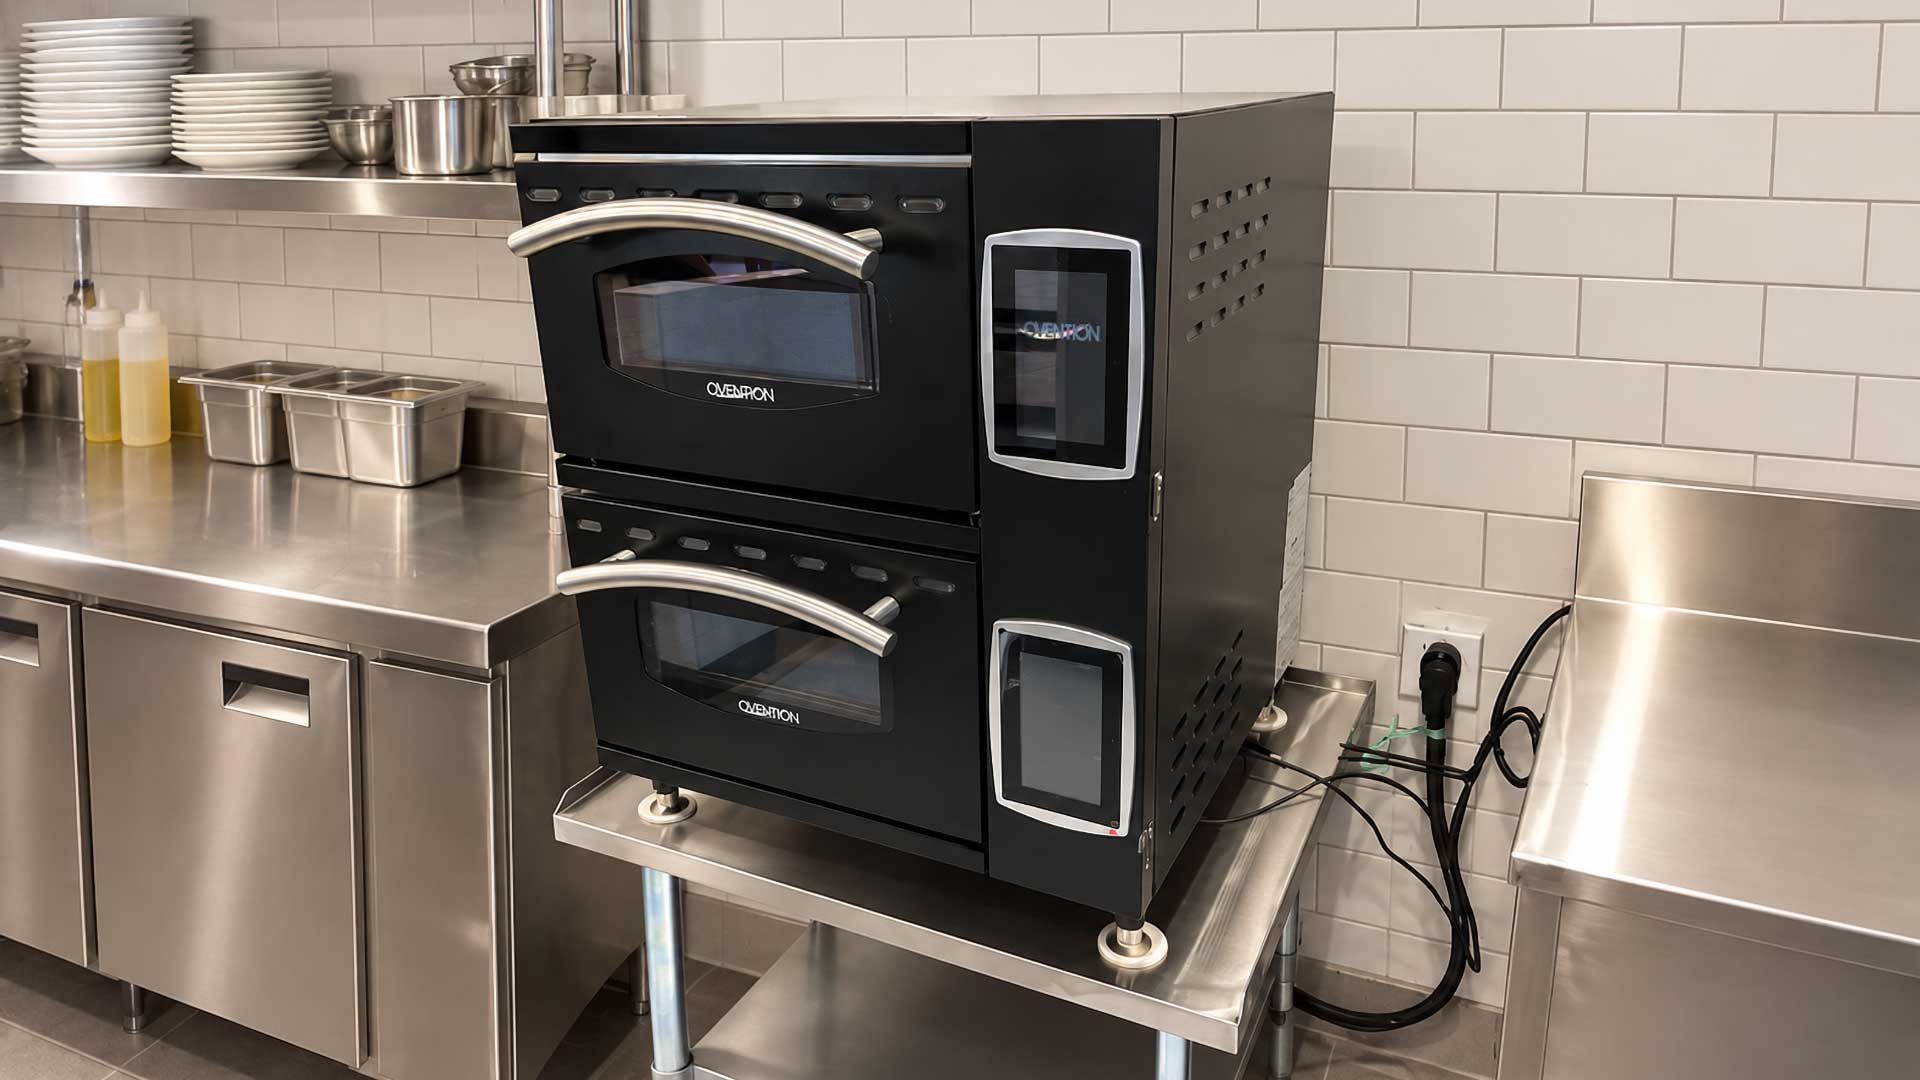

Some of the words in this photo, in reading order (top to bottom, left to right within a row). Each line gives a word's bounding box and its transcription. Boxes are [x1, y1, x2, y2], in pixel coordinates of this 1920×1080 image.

[1023, 321, 1101, 342] OVENTION
[706, 381, 775, 402] OVENTION
[738, 699, 800, 725] OVENTION
